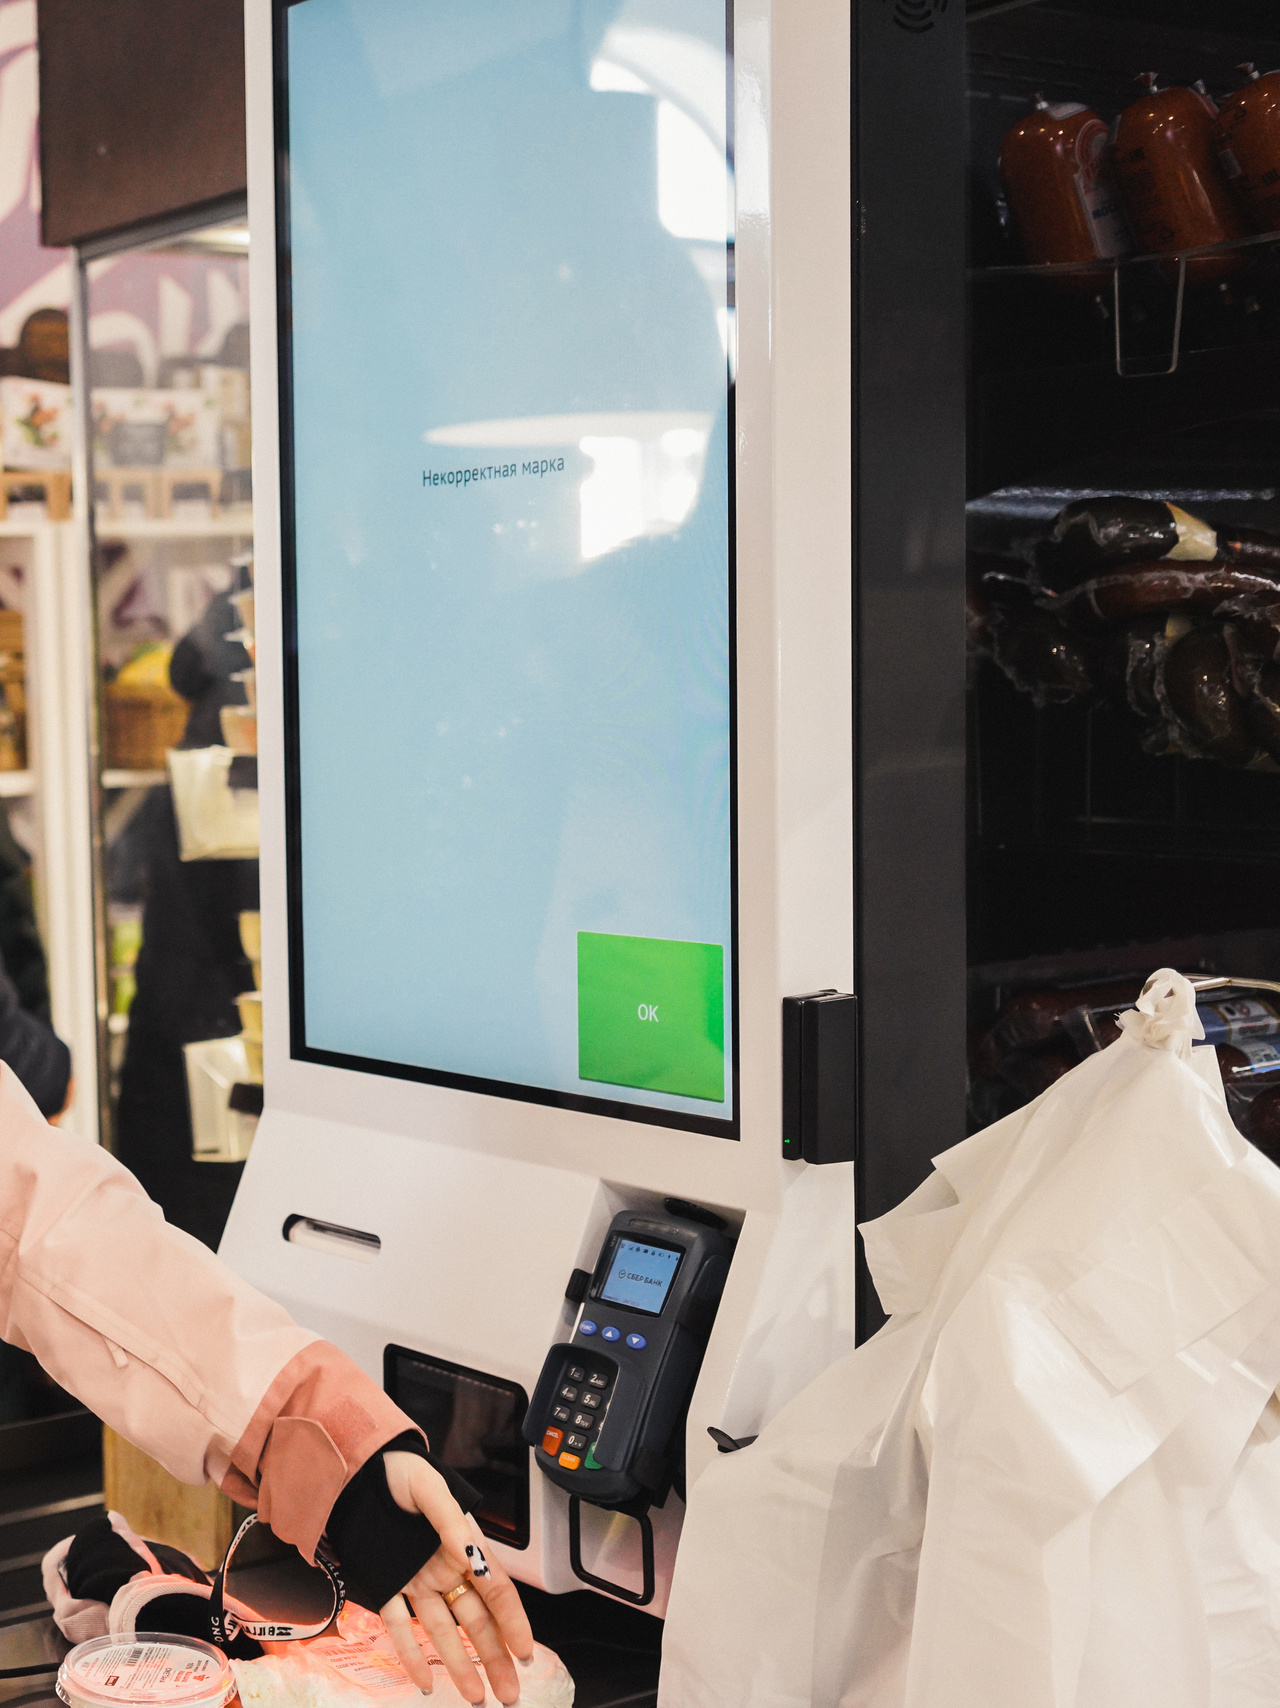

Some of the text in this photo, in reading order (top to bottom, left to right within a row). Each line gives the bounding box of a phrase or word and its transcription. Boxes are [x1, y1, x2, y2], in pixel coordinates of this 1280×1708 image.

[422, 457, 565, 488] Некорректная марка
[637, 1003, 659, 1023] OK
